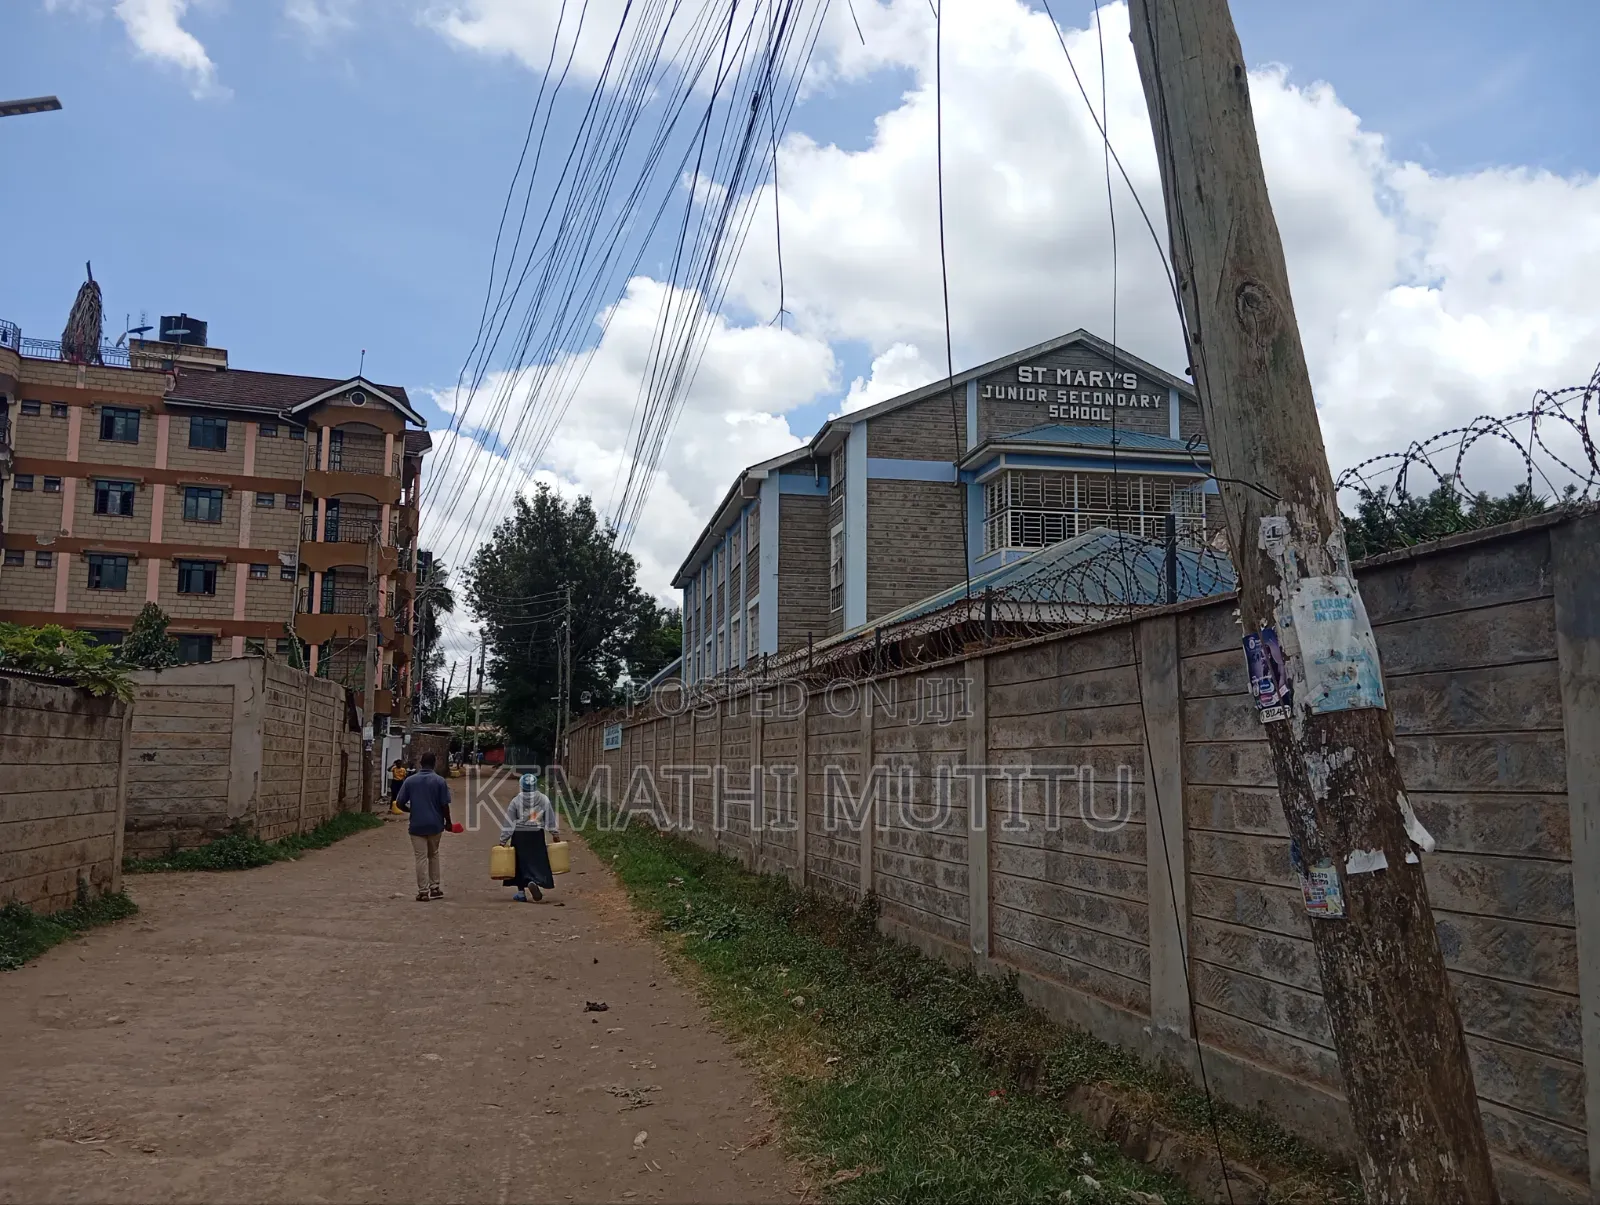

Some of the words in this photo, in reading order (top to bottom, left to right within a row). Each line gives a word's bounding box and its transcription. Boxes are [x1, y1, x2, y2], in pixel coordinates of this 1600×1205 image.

[1018, 365, 1047, 383] ST
[1057, 368, 1138, 390] MARY'S
[982, 385, 1048, 402] JUNIOR
[1057, 390, 1161, 408] SECONDARY
[1049, 405, 1111, 421] SCHOOL
